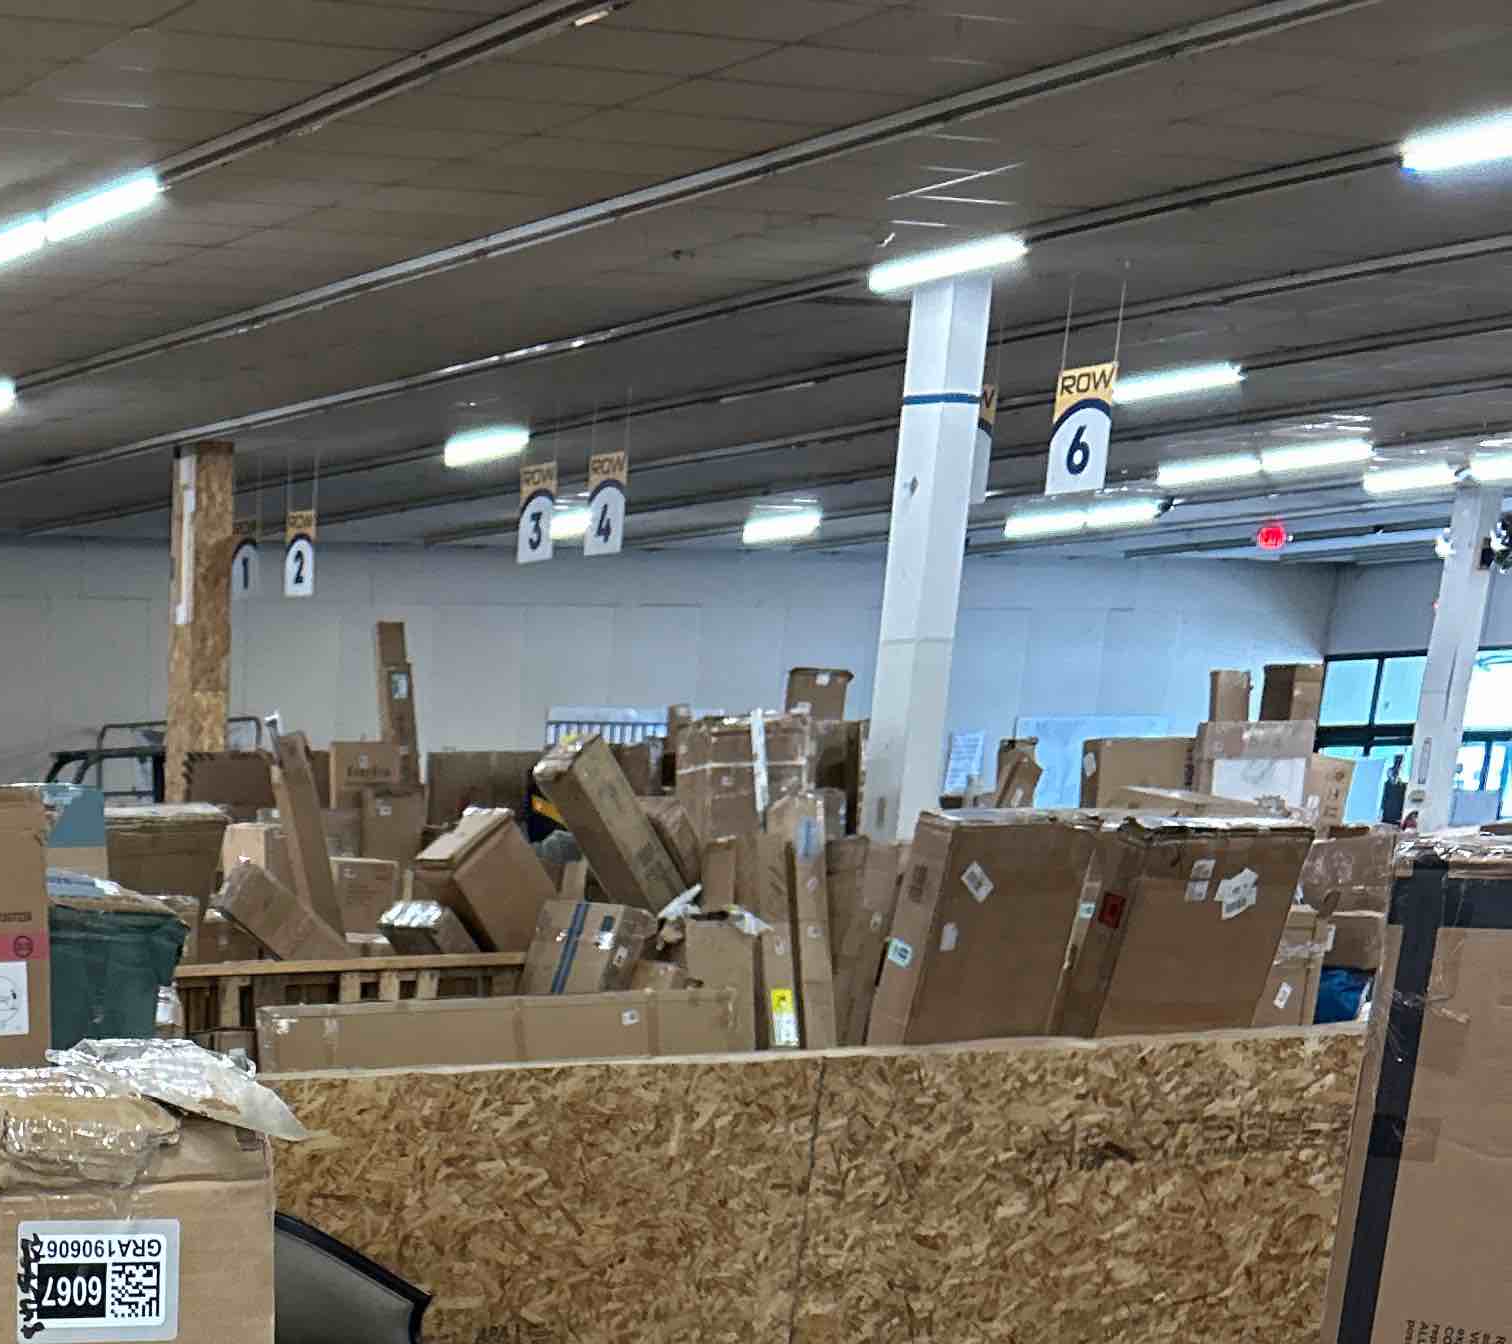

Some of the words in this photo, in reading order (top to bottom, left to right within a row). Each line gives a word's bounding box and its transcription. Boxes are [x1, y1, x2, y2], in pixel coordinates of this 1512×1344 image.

[1060, 369, 1112, 396] ROW
[591, 453, 626, 476] ROW
[1066, 425, 1089, 475] 6
[523, 468, 555, 487] ROW
[289, 511, 314, 530] ROW
[529, 511, 542, 551] 3
[596, 504, 612, 543] 4
[241, 557, 250, 590] 1
[292, 549, 305, 585] 2
[37, 1238, 162, 1258] GRA1906067
[40, 1275, 103, 1307] 6067
[1417, 1320, 1429, 1344] ALL
